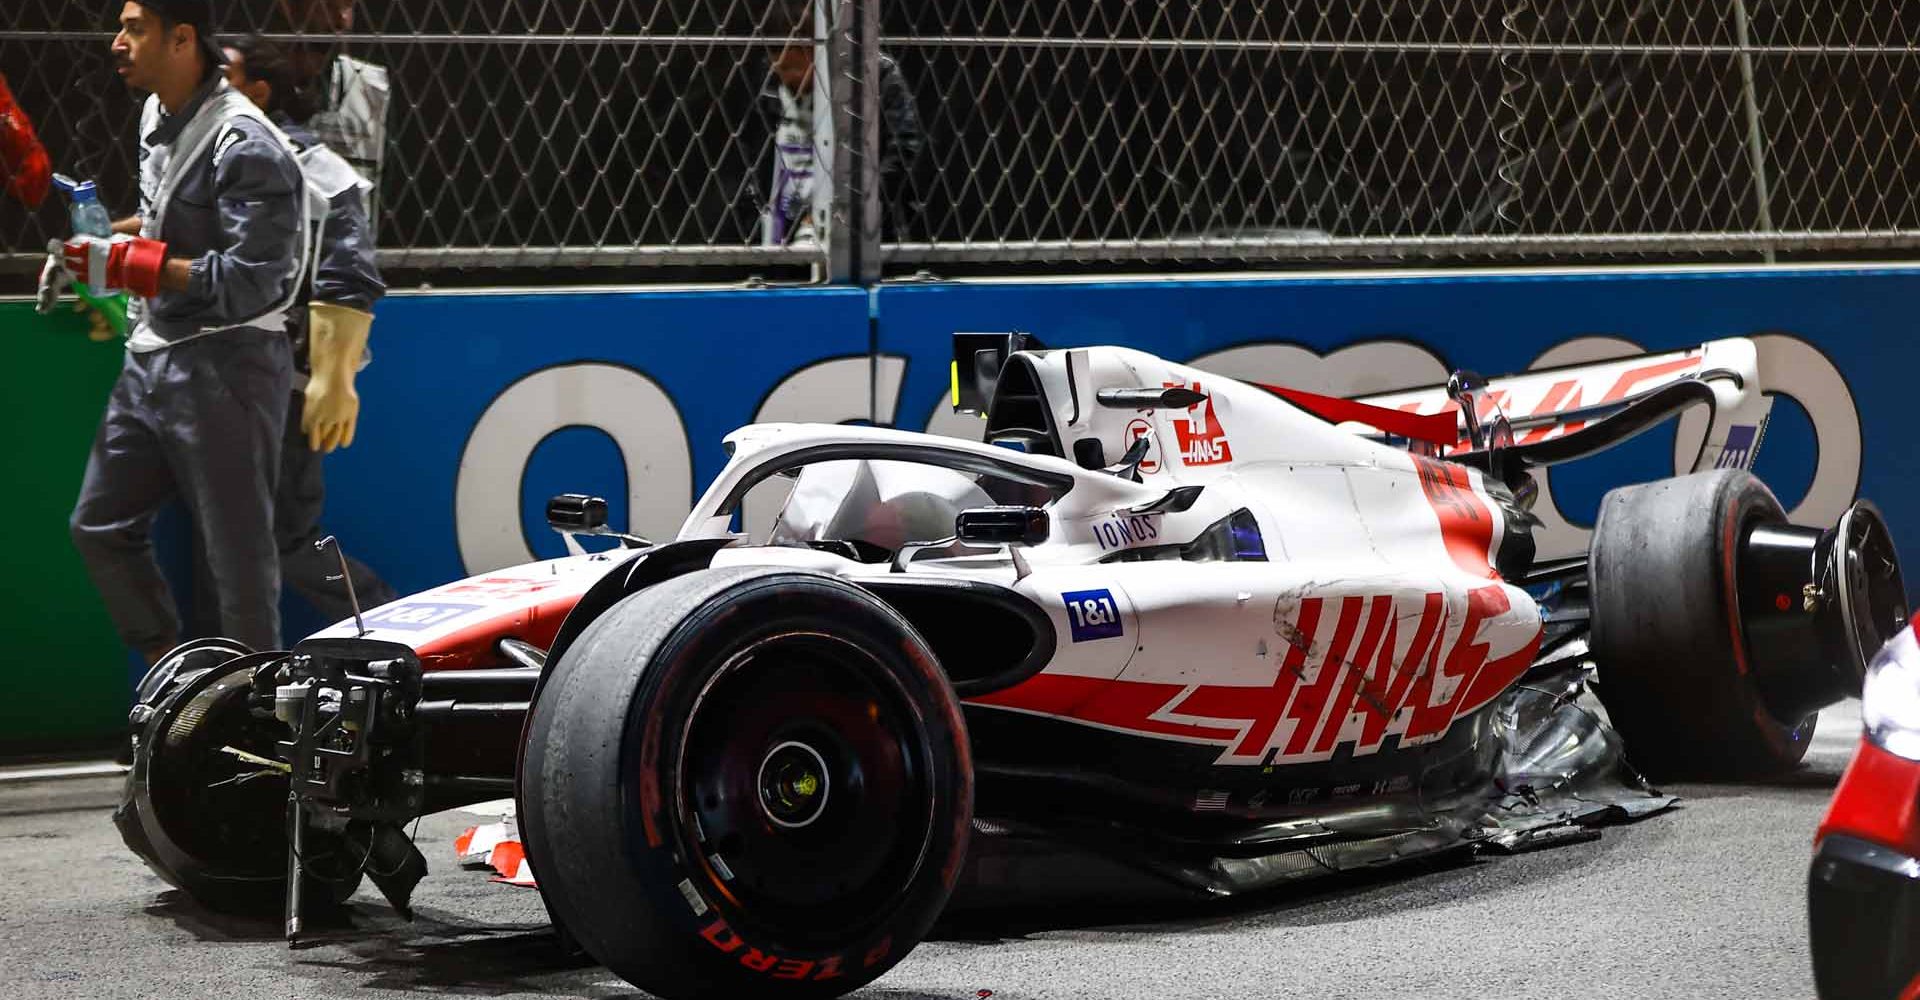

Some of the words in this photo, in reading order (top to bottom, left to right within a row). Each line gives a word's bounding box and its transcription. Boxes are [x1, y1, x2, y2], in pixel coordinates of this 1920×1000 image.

[1181, 435, 1224, 463] HAAS
[1092, 514, 1157, 551] IONOS
[1068, 597, 1116, 627] 1&1
[1231, 585, 1512, 757] HAAS
[699, 916, 844, 981] ZERO
